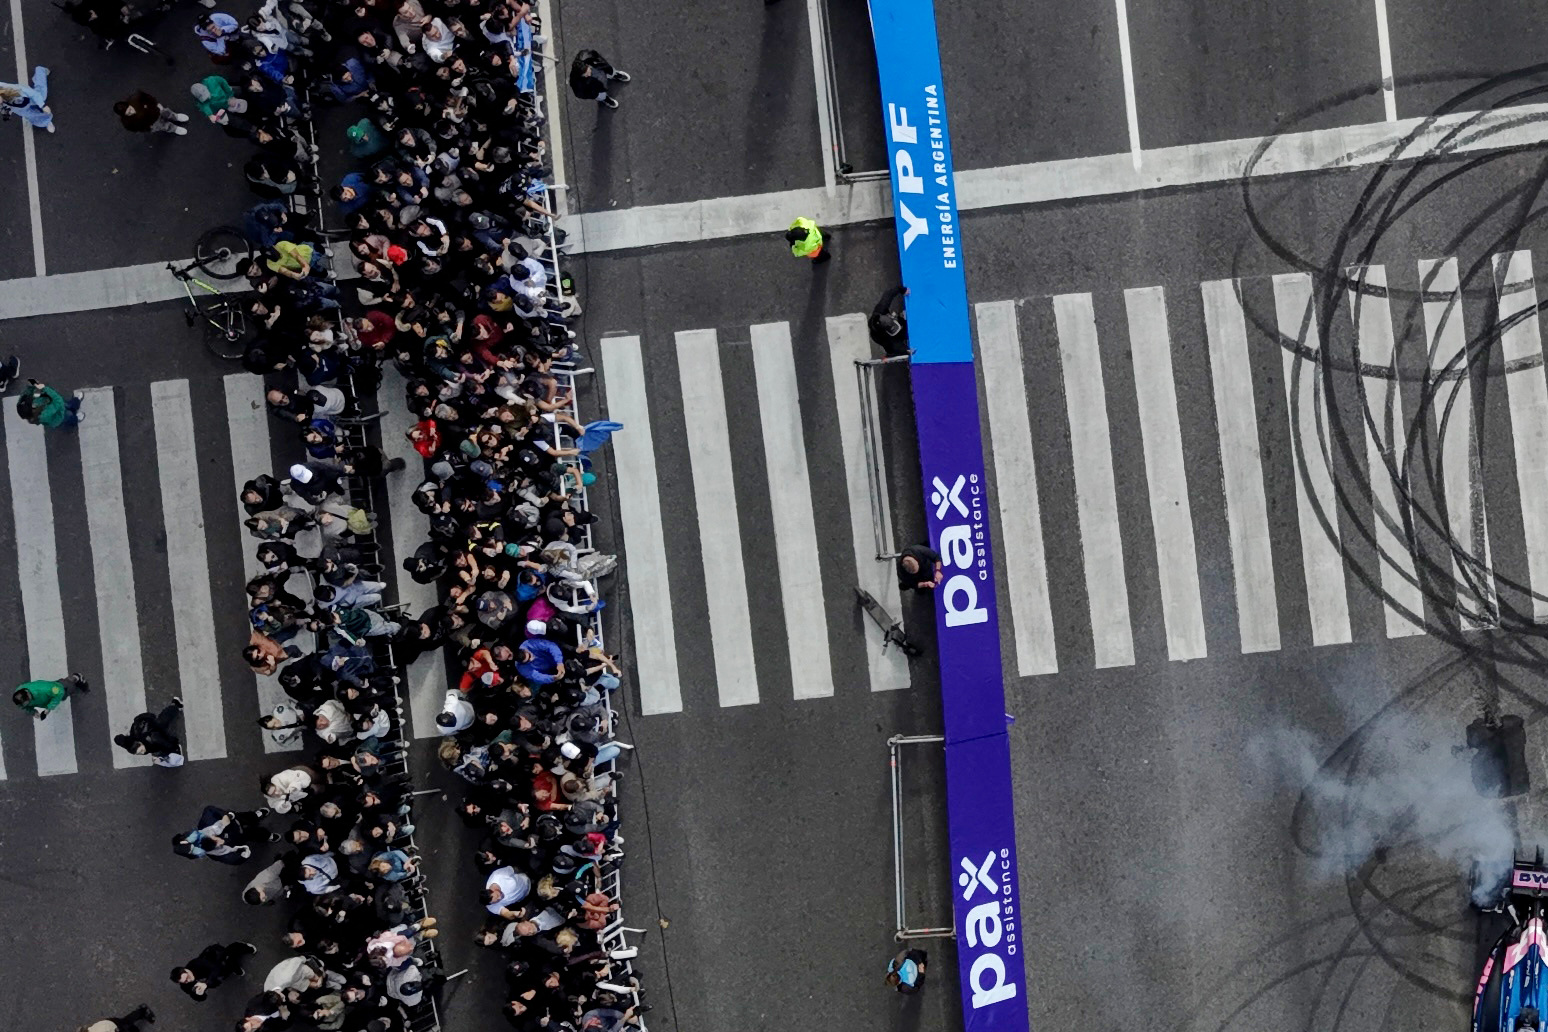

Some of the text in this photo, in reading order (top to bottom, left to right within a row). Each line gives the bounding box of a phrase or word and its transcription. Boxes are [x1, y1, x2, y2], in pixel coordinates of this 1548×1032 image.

[888, 102, 929, 251] YPF
[924, 84, 957, 268] ENERGÍA ARGENTINA
[931, 474, 988, 627] pax
[970, 473, 988, 580] assistance
[958, 850, 1017, 1009] pax
[1000, 848, 1016, 955] assistance
